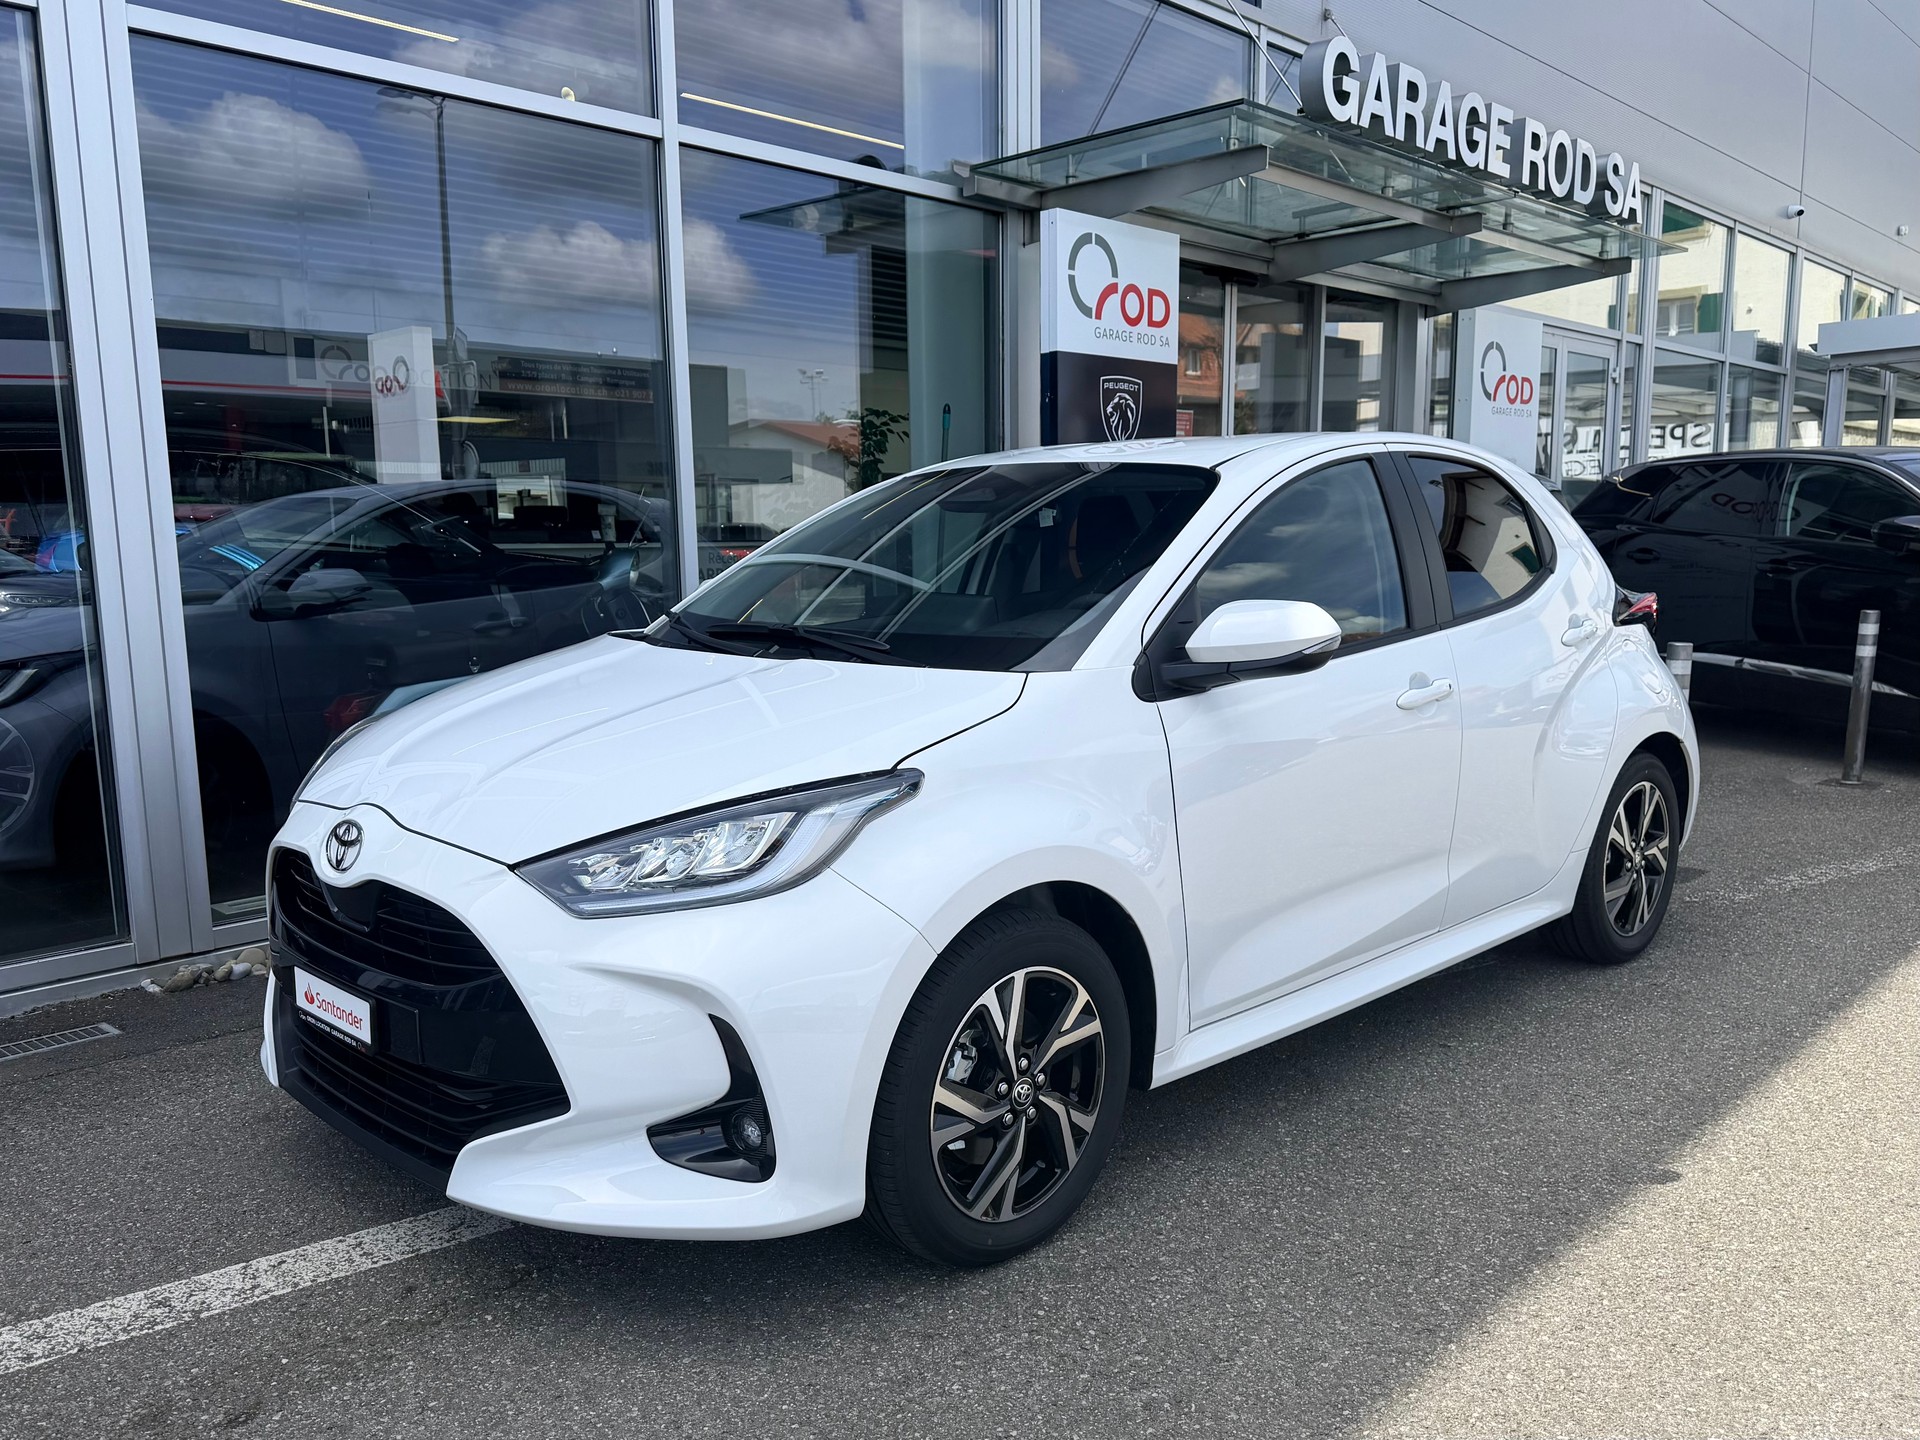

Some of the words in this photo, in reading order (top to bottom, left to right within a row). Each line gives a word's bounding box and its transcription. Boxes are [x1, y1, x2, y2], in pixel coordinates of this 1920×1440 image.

[1321, 35, 1514, 179] GARAGE
[1522, 116, 1597, 205] ROD
[1604, 152, 1643, 225] SA
[1094, 326, 1134, 343] GARAGE
[1137, 332, 1157, 346] ROD
[1159, 336, 1170, 348] SA
[1103, 381, 1139, 392] PEUGEOT
[1491, 406, 1514, 416] GARAGE
[1514, 408, 1526, 418] ROD
[1526, 409, 1532, 418] SA
[315, 992, 363, 1031] Santander
